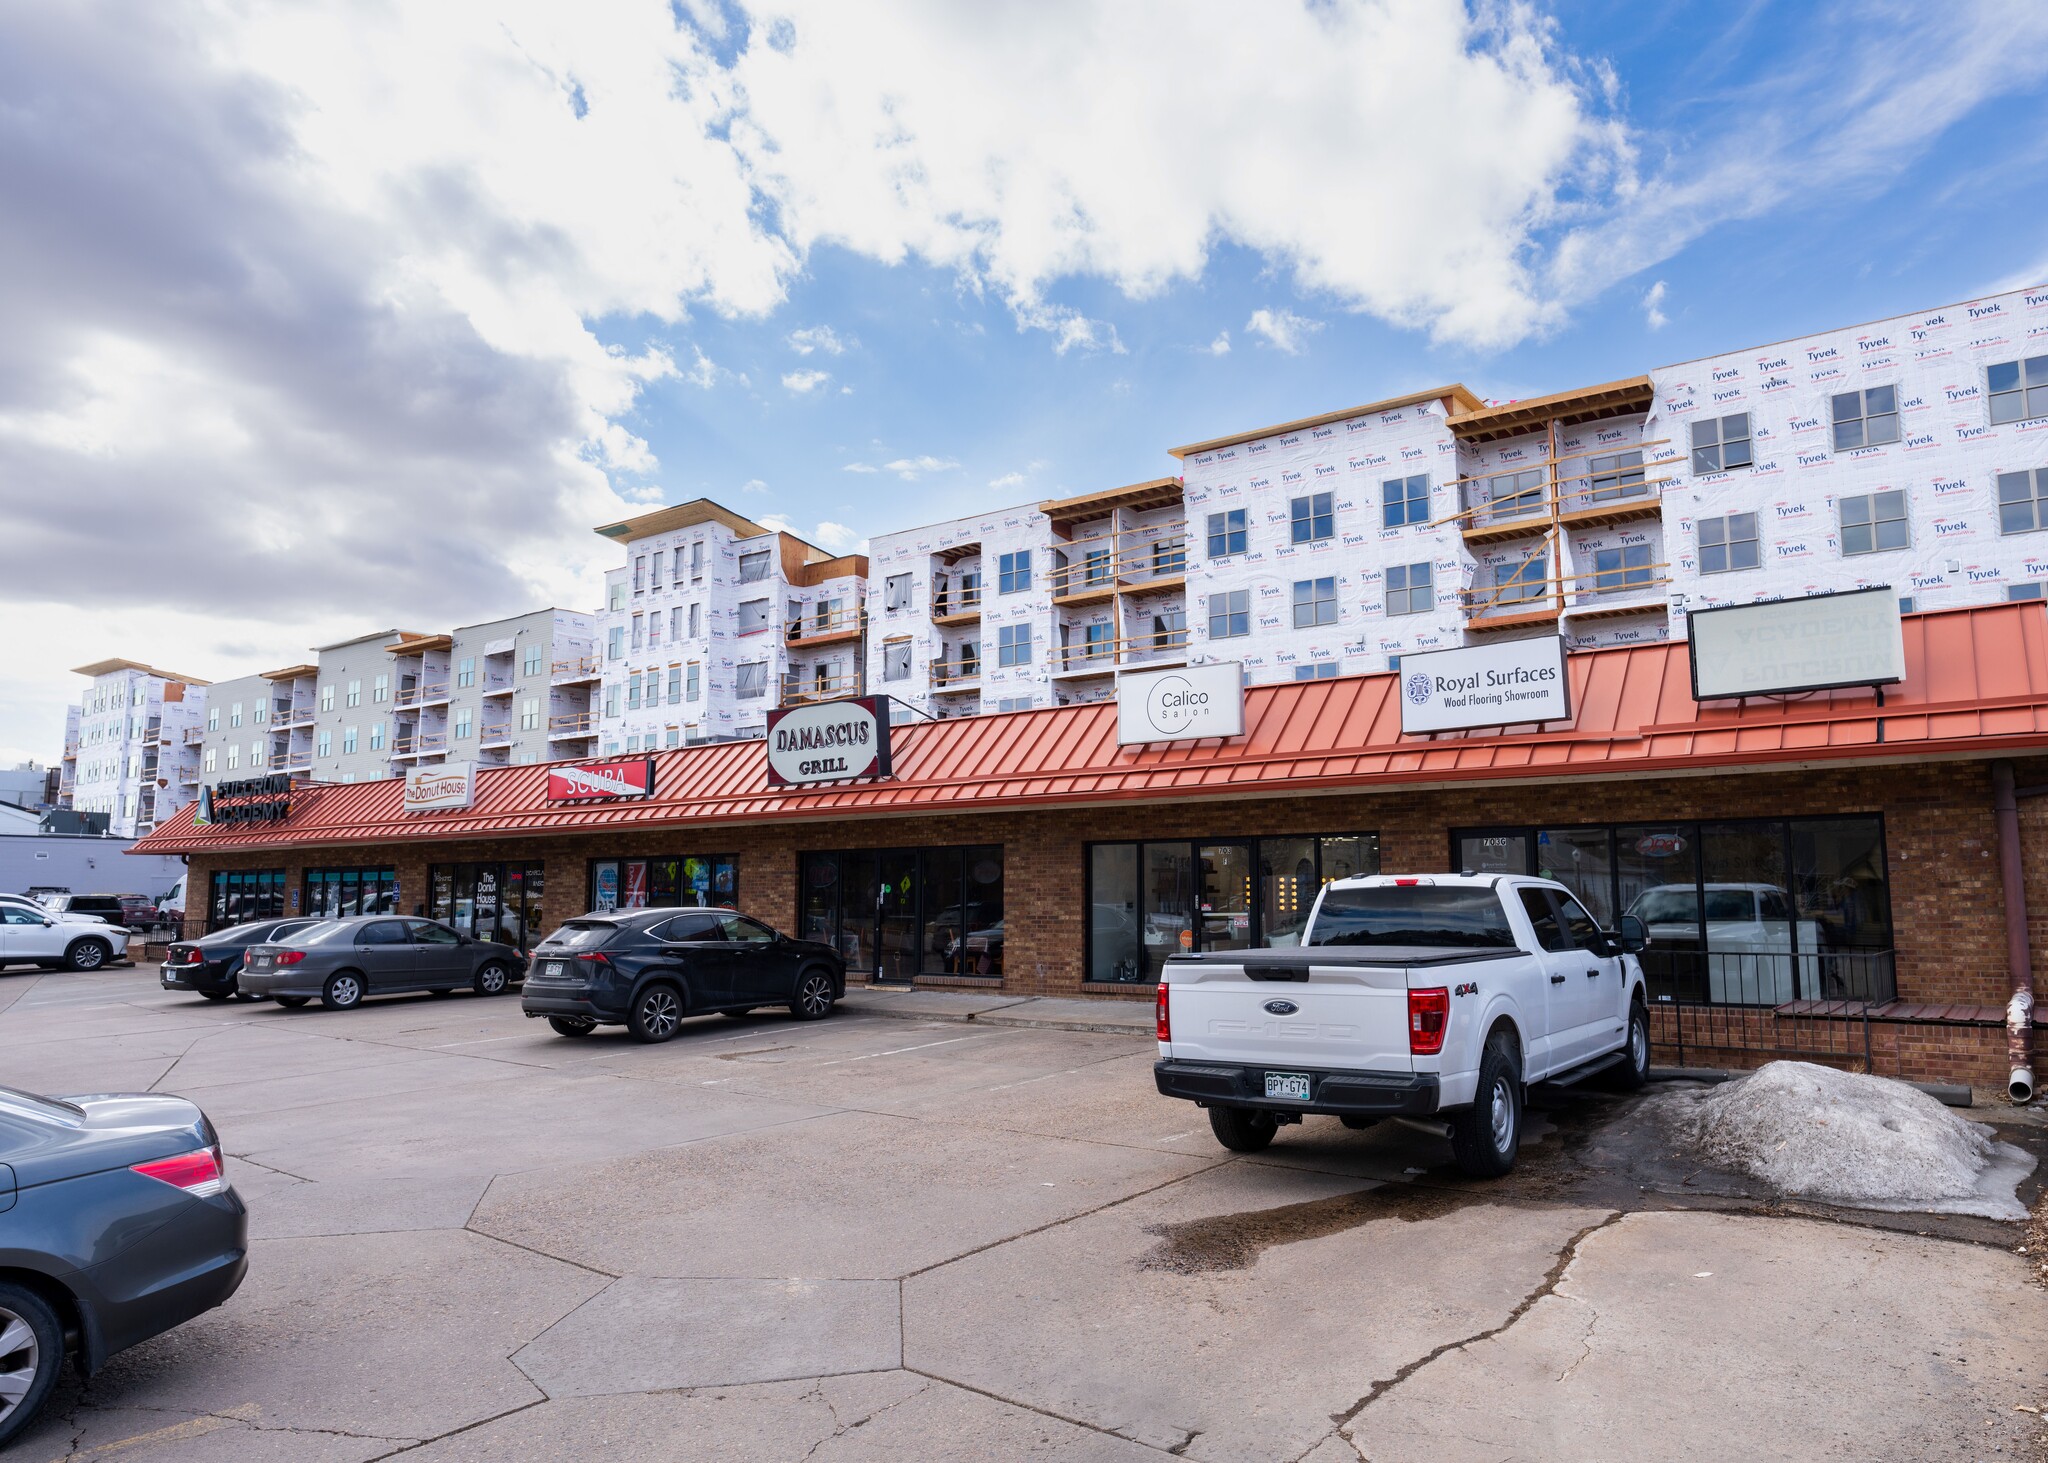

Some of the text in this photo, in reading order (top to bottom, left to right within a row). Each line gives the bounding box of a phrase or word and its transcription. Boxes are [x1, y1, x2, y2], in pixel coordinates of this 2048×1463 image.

[2025, 295, 2048, 305] Tyve
[1968, 304, 2000, 317] Tyvek
[1926, 316, 1944, 326] vek
[1858, 337, 1889, 350] Tyvek
[1807, 348, 1837, 361] Tyvek
[1758, 359, 1786, 371] Tyvek
[1713, 369, 1738, 381] Tyvek
[1712, 390, 1740, 400] Tyvek
[1946, 386, 1978, 400] Tyvek
[1667, 399, 1693, 412] Tyvek
[1904, 397, 1922, 407] vek
[1381, 413, 1401, 423] Tyvek
[1346, 421, 1366, 431] Tyvek
[1789, 418, 1818, 430] Tyvek
[1313, 429, 1332, 438] Tyvek
[1597, 431, 1621, 441] Tyvek
[1280, 436, 1298, 446] Tyvek
[1565, 439, 1580, 447] vek
[1907, 435, 1933, 447] yvek
[1248, 444, 1266, 453] Tyvek
[1438, 443, 1455, 451] Tyve
[1217, 451, 1235, 460] Tyvek
[1401, 449, 1422, 458] Tyvek
[1500, 449, 1522, 459] Tyvek
[1653, 449, 1675, 460] yvek
[1194, 456, 1212, 465] Tyvek
[1365, 455, 1386, 466] Tyvek
[1797, 453, 1827, 465] Tyvek
[1349, 460, 1366, 469] Tyve
[1315, 466, 1334, 475] Tyvek
[1283, 472, 1301, 481] Tyvek
[1251, 479, 1269, 488] Tyvek
[1661, 478, 1681, 489] yvek
[1933, 480, 1965, 492] Tyvek
[1220, 486, 1240, 495] Tyvek
[1190, 492, 1207, 503] Tyvek
[1337, 501, 1352, 510] yvek
[1776, 504, 1805, 516] Tyvek
[1028, 514, 1044, 522] Tyvek
[1268, 513, 1286, 522] Tyvek
[1004, 519, 1018, 527] Tyvek
[1934, 521, 1967, 534] Tyvek
[1343, 535, 1363, 544] Tyvek
[1620, 534, 1645, 544] Tyvek
[1308, 540, 1328, 550] Tyvek
[1578, 540, 1602, 550] Tyvek
[1777, 544, 1806, 555] Tyvek
[1244, 551, 1263, 561] Tyvek
[1275, 546, 1295, 556] Tyvek
[878, 556, 890, 564] Tyvek
[1212, 557, 1231, 567] Tyvek
[1484, 555, 1506, 565] Tyvek
[1435, 560, 1456, 571] Tyvek
[2025, 564, 2048, 574] Tyve
[1362, 572, 1381, 581] Tyvek
[1967, 568, 2000, 581] Tyvek
[1911, 575, 1943, 587] Tyvek
[1261, 587, 1279, 596] Tyvek
[1437, 593, 1455, 603] yvek
[1011, 608, 1026, 616] Tyvek
[1361, 603, 1381, 612] Tyvek
[1673, 607, 1688, 615] vek
[1136, 610, 1151, 618] Tyvek
[1260, 617, 1278, 626] Tyvek
[1576, 636, 1596, 645] yvek
[1614, 631, 1639, 640] Tyvek
[1380, 641, 1401, 652] Tyvek
[1417, 637, 1438, 646] Tyvek
[1310, 650, 1330, 658] Tyvek
[1345, 645, 1365, 654] Tyvek
[1245, 657, 1263, 666] Tyvek
[1277, 654, 1296, 662] Tyvek
[1436, 667, 1556, 693] Royal Surfaces
[1162, 691, 1208, 707] Calico
[1444, 689, 1549, 708] Wood Flooring Showroom
[1162, 708, 1208, 719] Salon
[776, 721, 869, 752] DAMASCUS
[799, 757, 848, 775] GRILL
[566, 768, 626, 794] SCUBA
[217, 776, 288, 799] FULCRUM
[407, 781, 465, 800] The Donut House
[216, 802, 287, 824] ACADEMY
[483, 872, 494, 882] The
[478, 882, 496, 892] Donut
[477, 894, 496, 903] House
[1270, 1003, 1290, 1013] Ford
